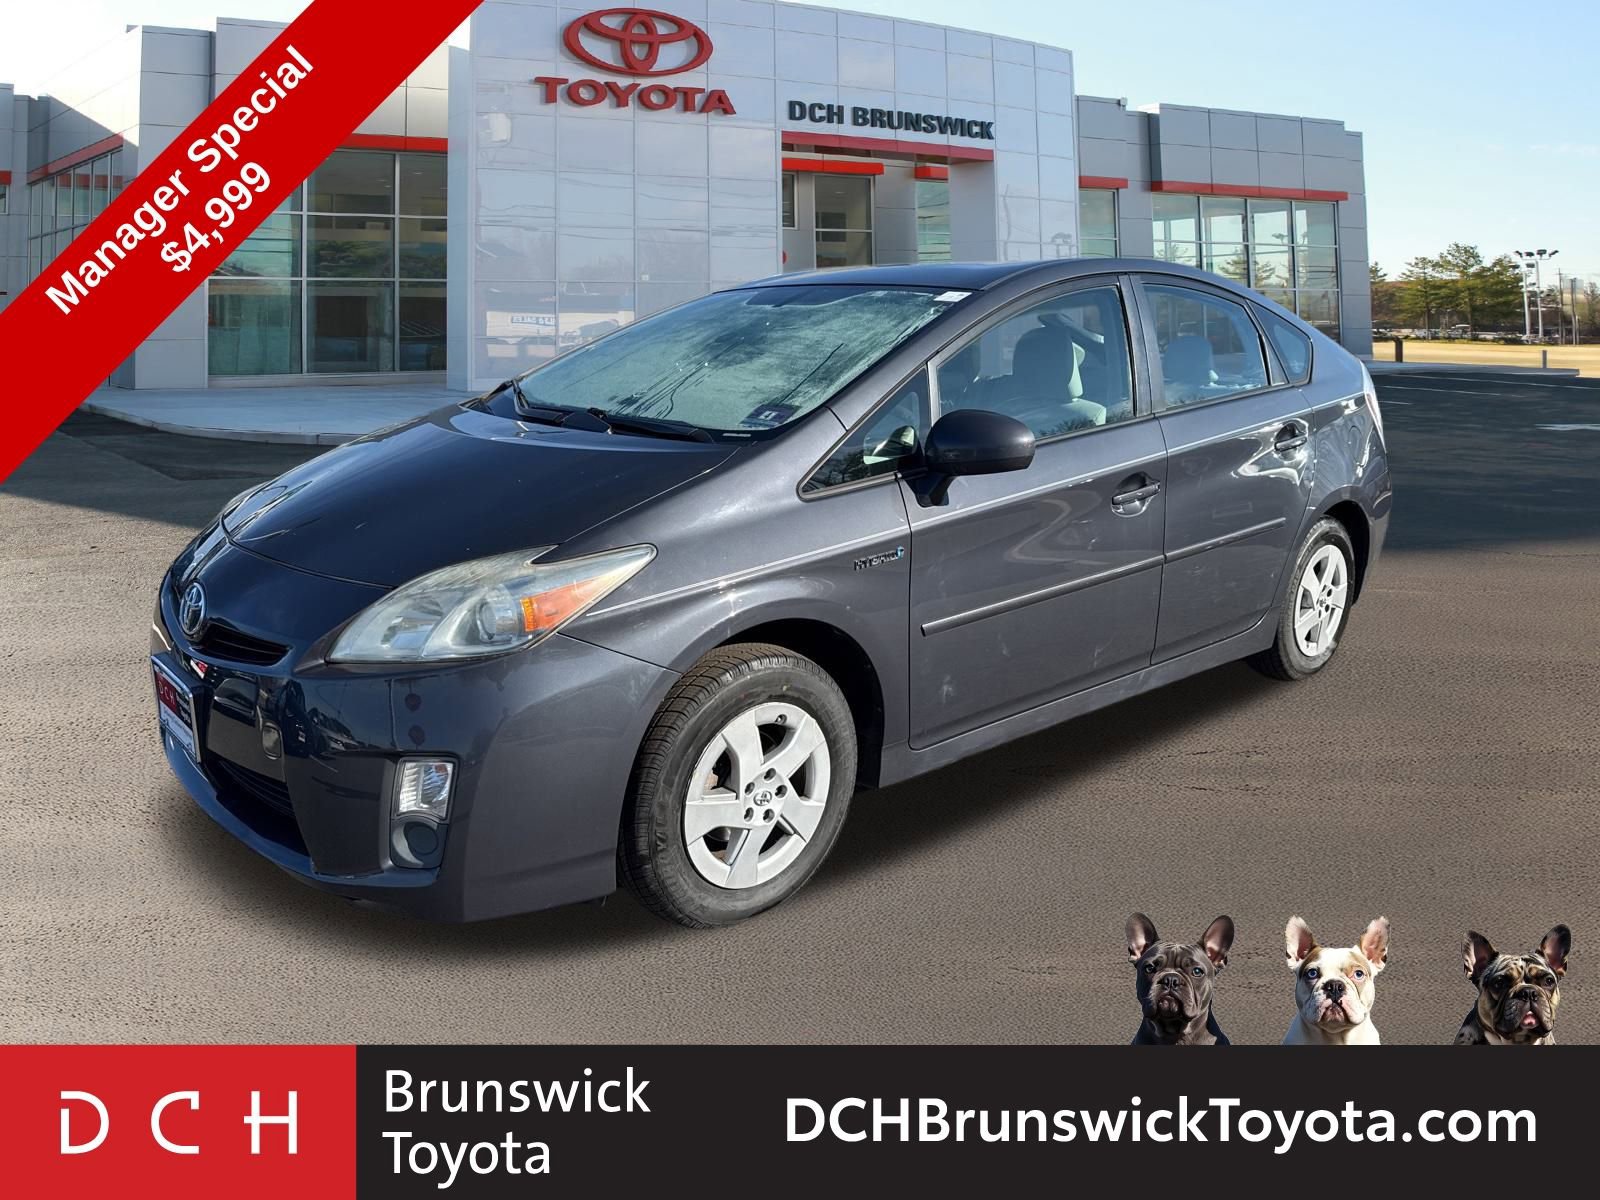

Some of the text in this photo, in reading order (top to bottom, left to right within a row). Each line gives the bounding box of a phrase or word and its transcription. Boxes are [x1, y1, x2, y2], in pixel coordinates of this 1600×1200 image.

[534, 76, 736, 115] TOYOTA
[788, 100, 994, 140] DCH BRUNSWICK
